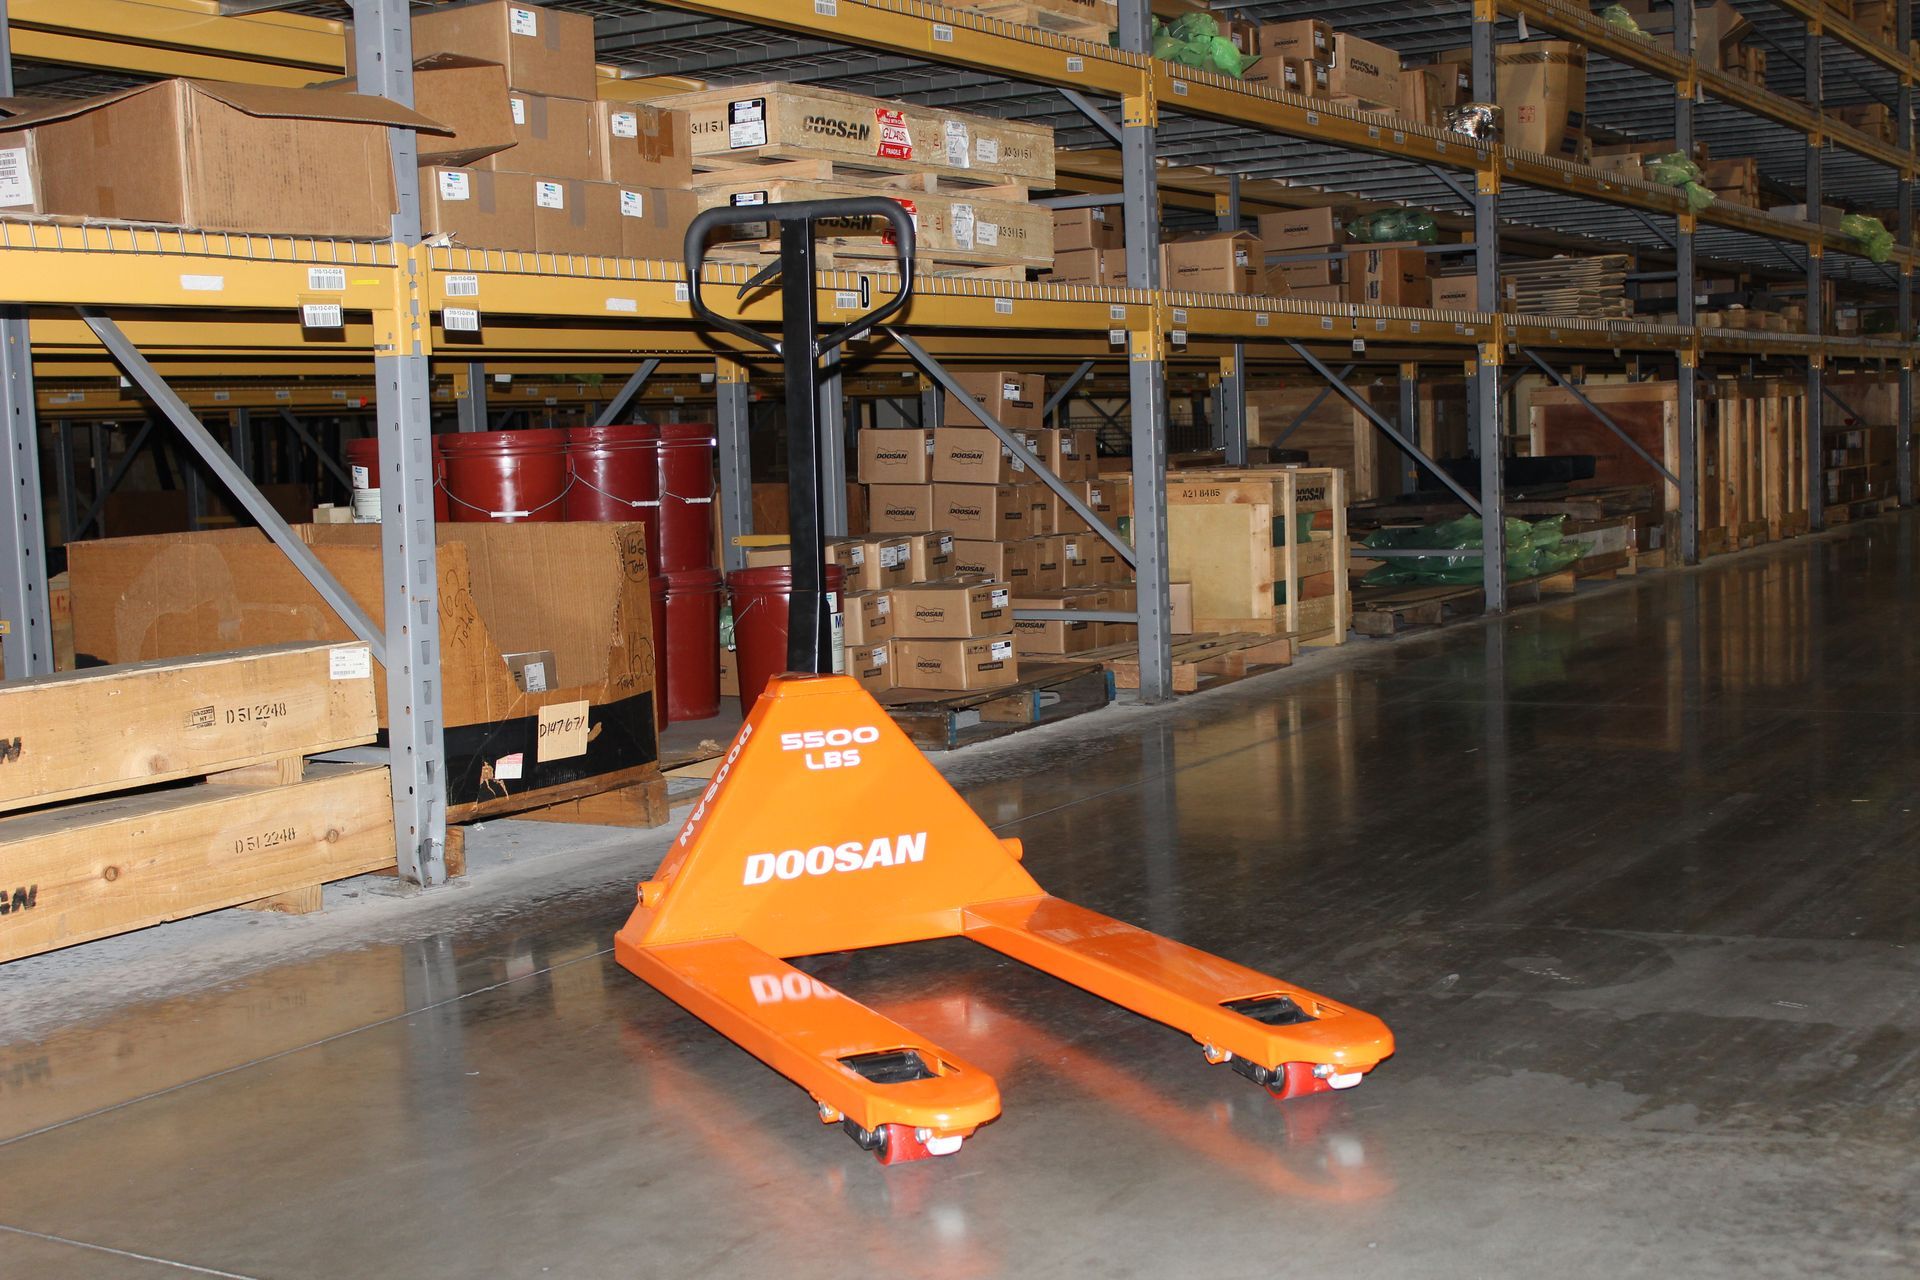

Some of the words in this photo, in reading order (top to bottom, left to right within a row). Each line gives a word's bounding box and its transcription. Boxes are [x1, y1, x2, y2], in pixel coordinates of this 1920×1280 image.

[1350, 57, 1379, 78] DOOSAN
[803, 115, 871, 141] DOOSAN
[882, 127, 907, 142] GLASS
[861, 275, 870, 308] D
[876, 452, 907, 460] DOOSAN
[951, 452, 983, 460] DOOSAN
[885, 509, 916, 517] DOOSAN
[950, 508, 980, 517] DOOSAN
[955, 565, 985, 573] DOOSAN
[916, 610, 944, 618] DOOSAN
[1015, 621, 1046, 630] DOOSAN
[917, 662, 942, 670] DOOSAN
[780, 726, 880, 750] 5500
[805, 750, 862, 770] LBS
[679, 723, 753, 847] DOOSAN
[743, 832, 928, 886] DOOSAN
